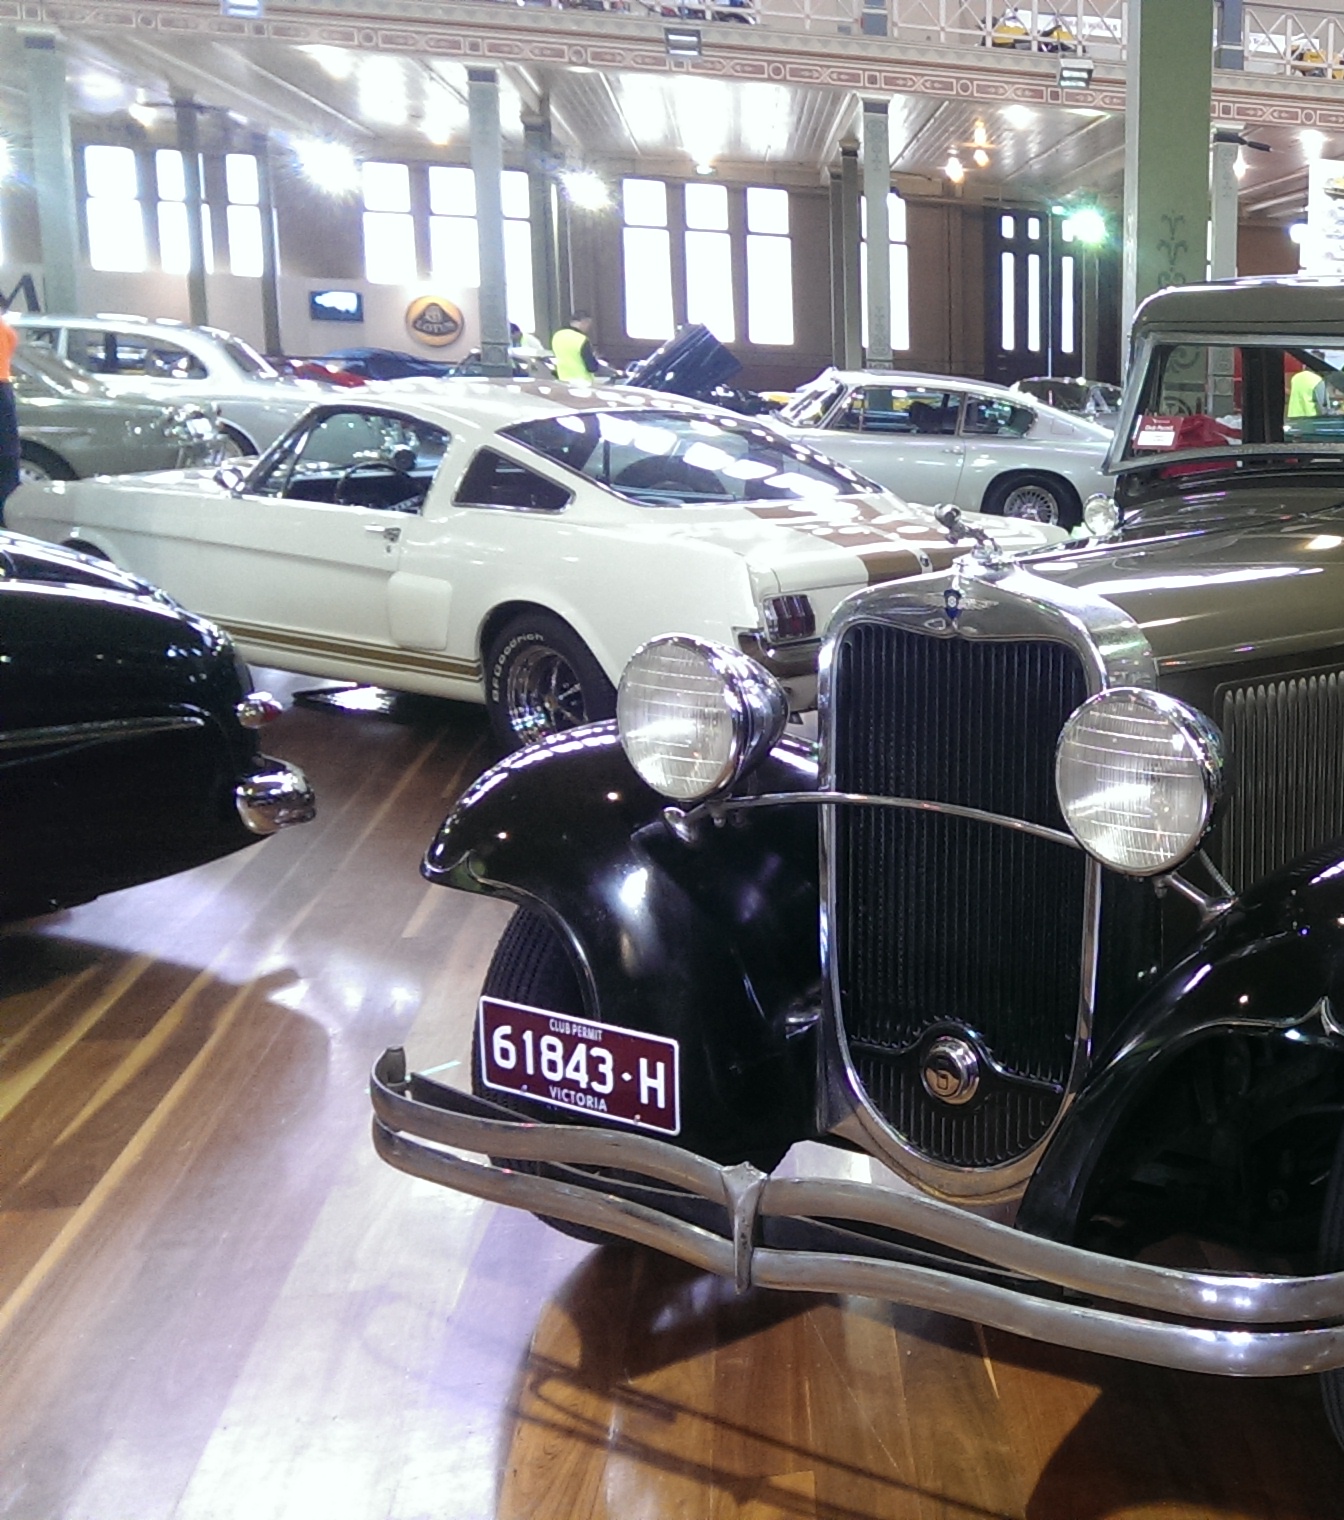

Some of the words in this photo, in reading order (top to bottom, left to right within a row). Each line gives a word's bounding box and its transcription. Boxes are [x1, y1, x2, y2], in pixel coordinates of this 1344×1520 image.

[549, 1018, 571, 1034] CLUB
[572, 1023, 603, 1041] PERMIT
[549, 1085, 608, 1112] VICTORIA
